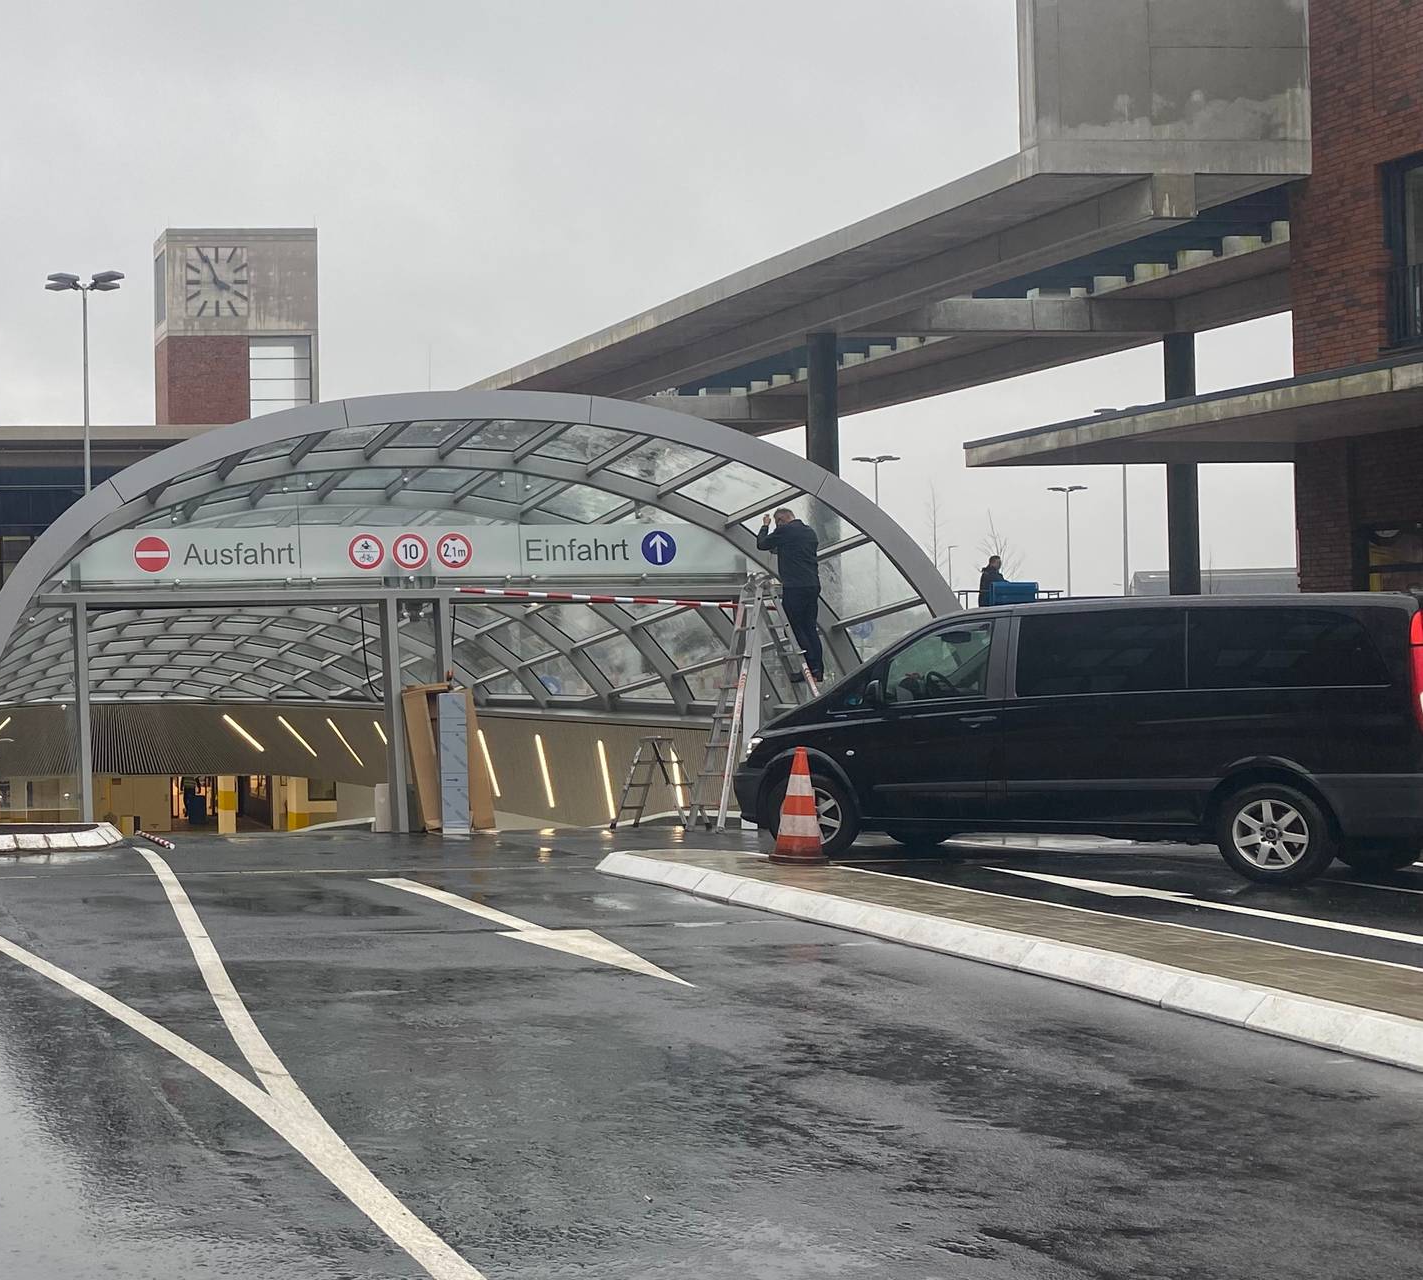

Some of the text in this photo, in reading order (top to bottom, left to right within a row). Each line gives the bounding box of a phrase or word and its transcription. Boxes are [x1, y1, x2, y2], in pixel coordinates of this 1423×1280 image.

[183, 542, 295, 566] Ausfahrt
[402, 543, 419, 560] 10
[526, 538, 630, 562] Einfahrt
